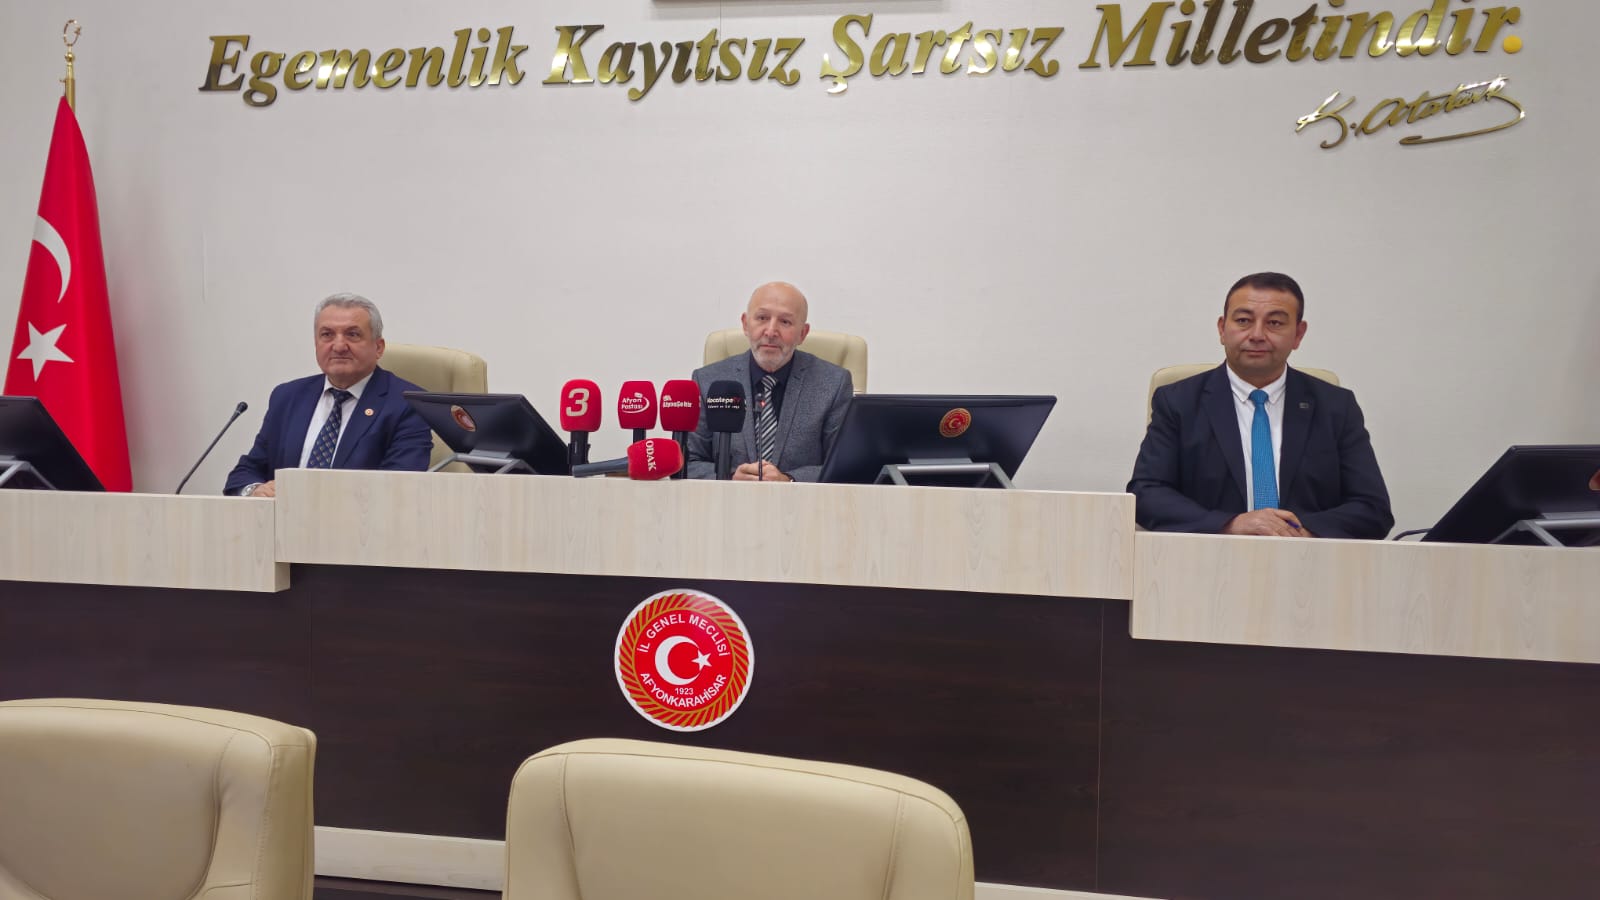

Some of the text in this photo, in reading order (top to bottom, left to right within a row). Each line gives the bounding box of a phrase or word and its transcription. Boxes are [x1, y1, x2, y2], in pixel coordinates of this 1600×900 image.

[198, 26, 528, 107] Egemenlik
[542, 24, 805, 101] Kayıtsız
[819, 13, 1064, 94] Şartsız
[565, 387, 590, 417] 3
[645, 440, 657, 471] ODAK
[637, 614, 731, 657] İL GENEL MECLİSİ
[640, 672, 727, 708] AFYONKARAHİSAR
[675, 687, 694, 695] 1923
